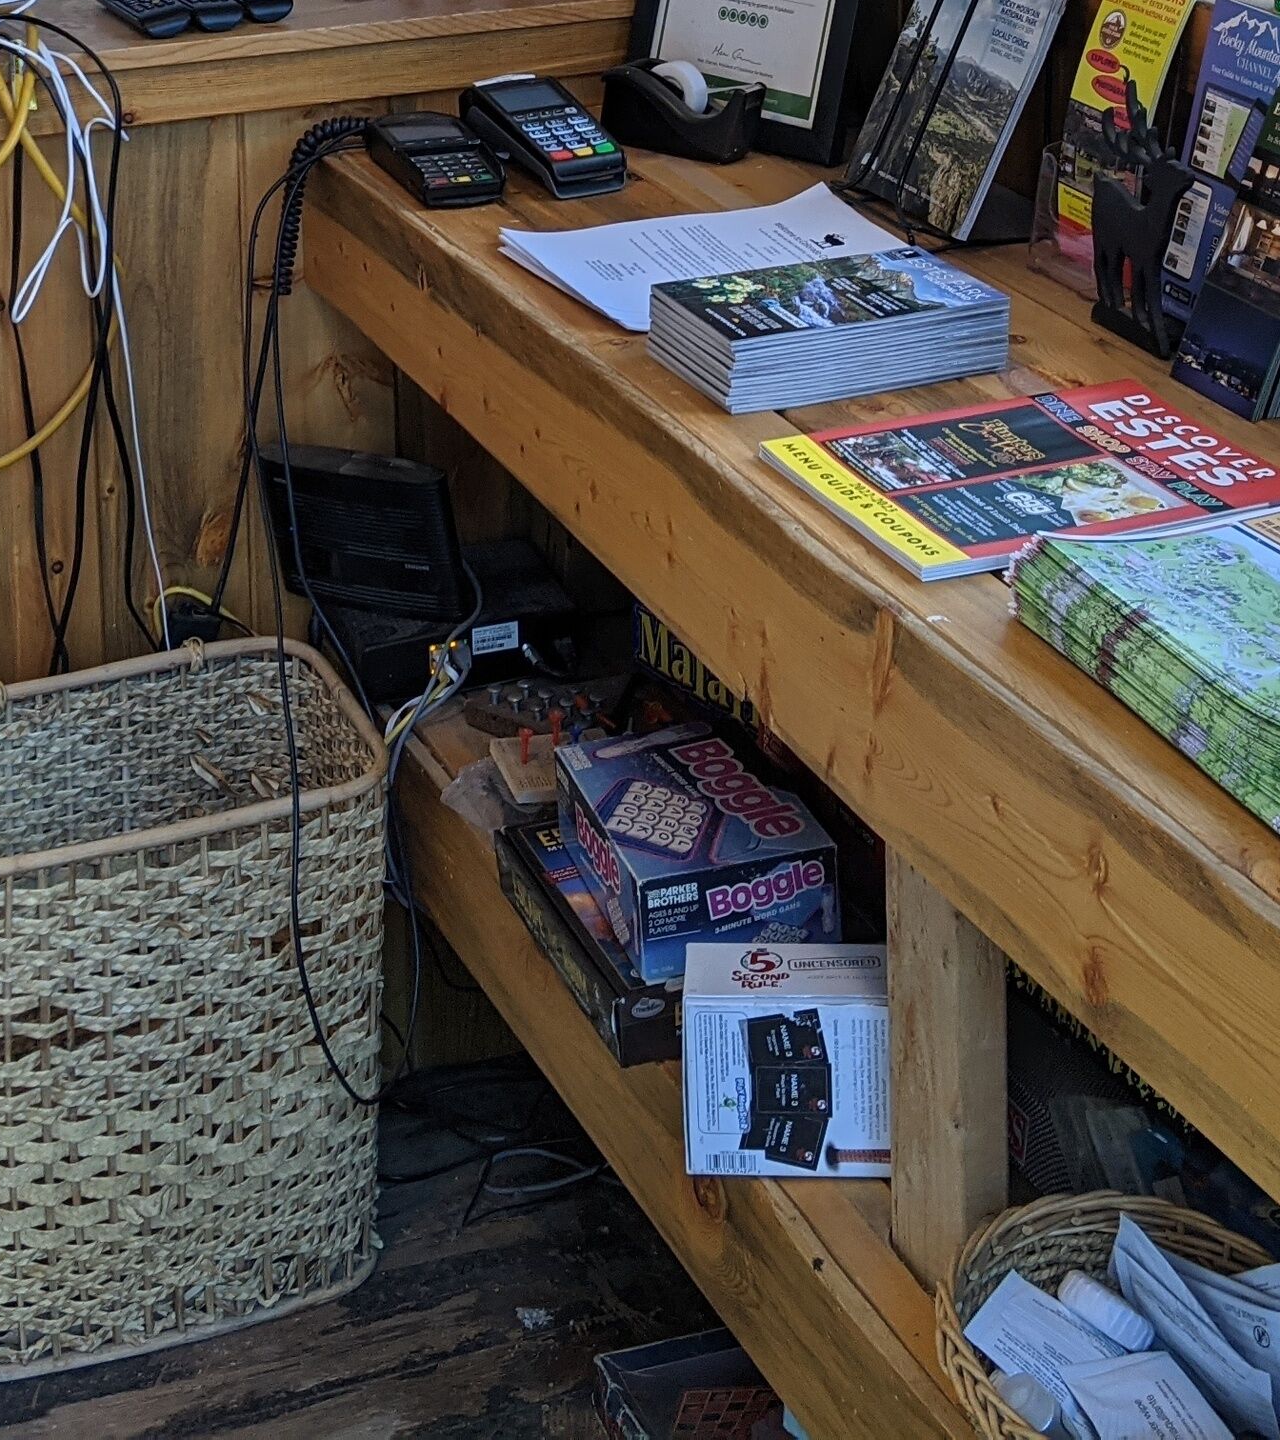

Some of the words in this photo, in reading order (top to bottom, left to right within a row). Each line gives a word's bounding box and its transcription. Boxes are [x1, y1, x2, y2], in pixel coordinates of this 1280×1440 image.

[1219, 29, 1246, 57] Rocky
[1236, 57, 1272, 80] CHANNEL
[1087, 399, 1249, 487] ESTES
[1122, 393, 1277, 480] DISCOVER
[782, 441, 822, 470] MENU
[820, 472, 863, 502] GUIDE
[873, 511, 941, 558] COUPONS
[669, 737, 805, 839] Boggle
[647, 892, 699, 909] BROTHERS
[660, 882, 699, 897] PARKER
[706, 859, 825, 921] Boggle
[793, 956, 877, 969] UNCENSORED
[731, 969, 791, 982] SECOND
[741, 979, 783, 990] RULE.
